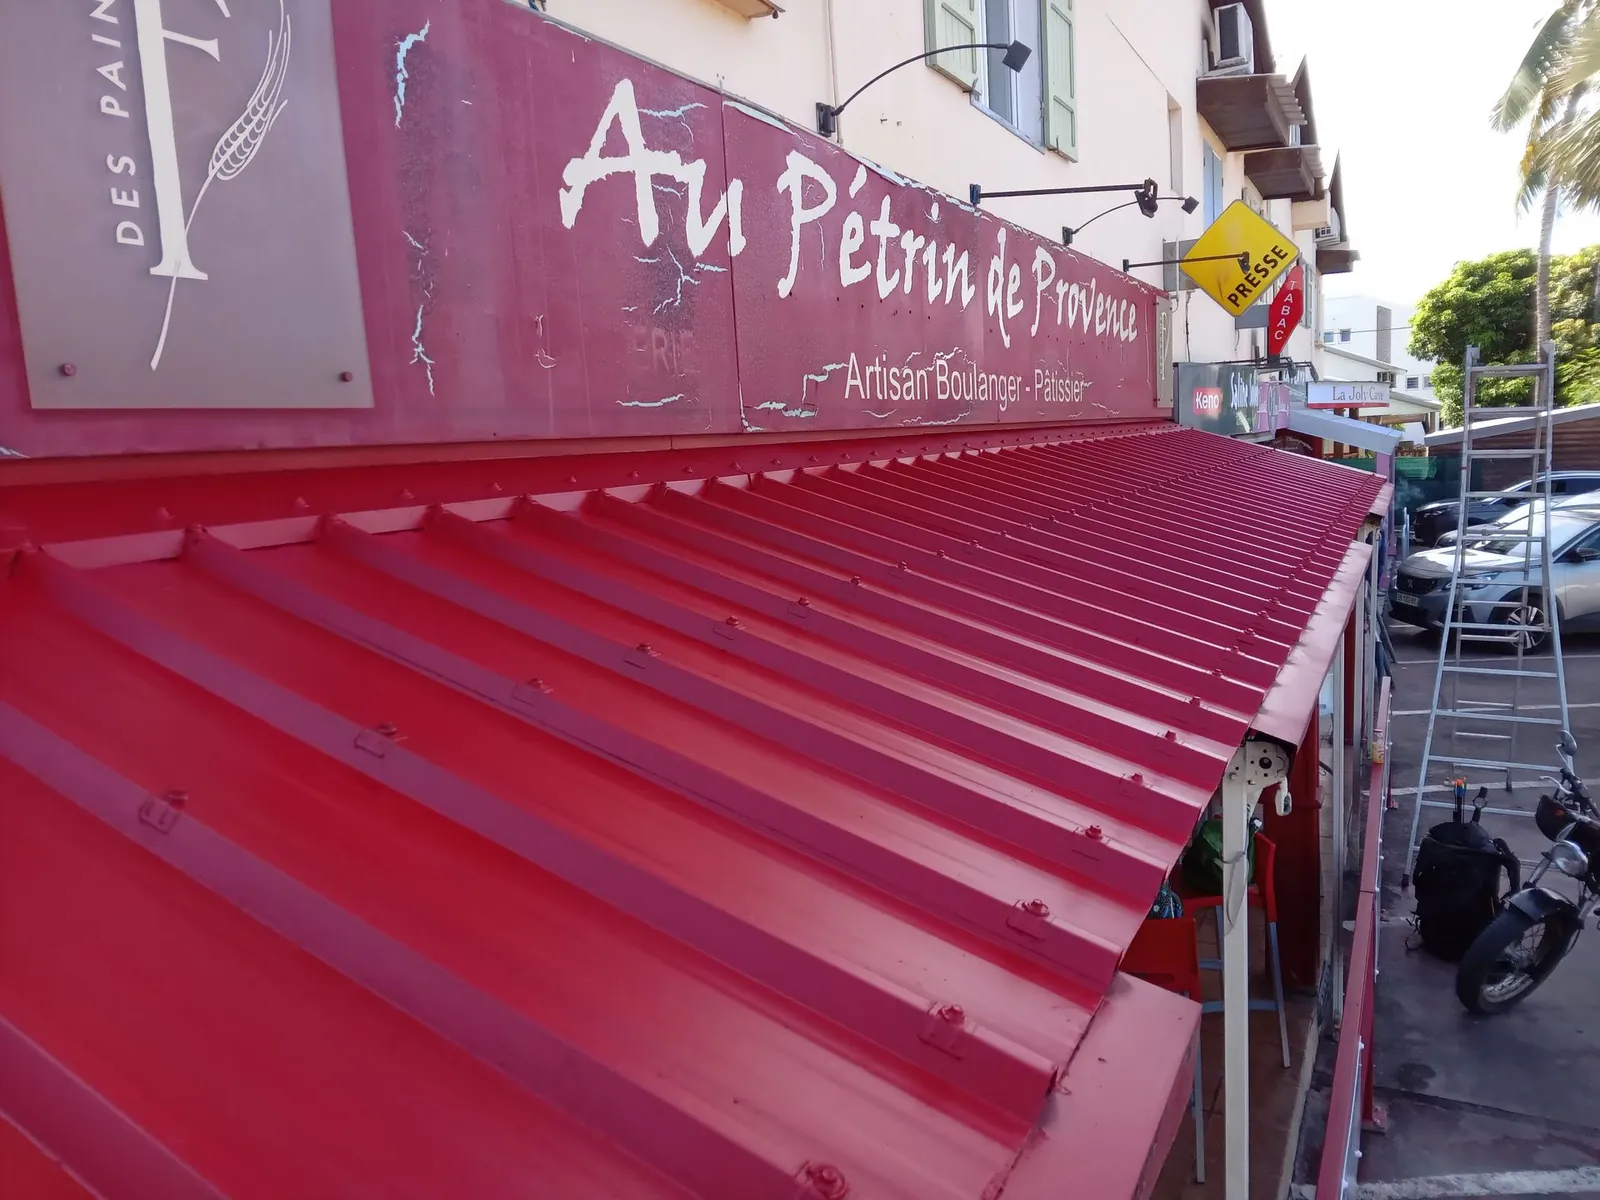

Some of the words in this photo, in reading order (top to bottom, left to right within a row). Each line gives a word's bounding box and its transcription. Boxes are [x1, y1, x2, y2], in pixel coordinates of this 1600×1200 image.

[106, 154, 145, 247] DES
[559, 78, 747, 258] Au
[776, 150, 976, 309] Pétrin
[987, 227, 1024, 348] de
[1031, 245, 1138, 343] Provence
[1227, 245, 1289, 308] PRESSE
[1274, 280, 1298, 340] TABAC
[845, 352, 929, 401] Artisan
[937, 359, 1022, 411] Boulanger
[1034, 369, 1085, 403] Pâtissier
[1195, 391, 1220, 410] Keno
[1332, 386, 1346, 401] La
